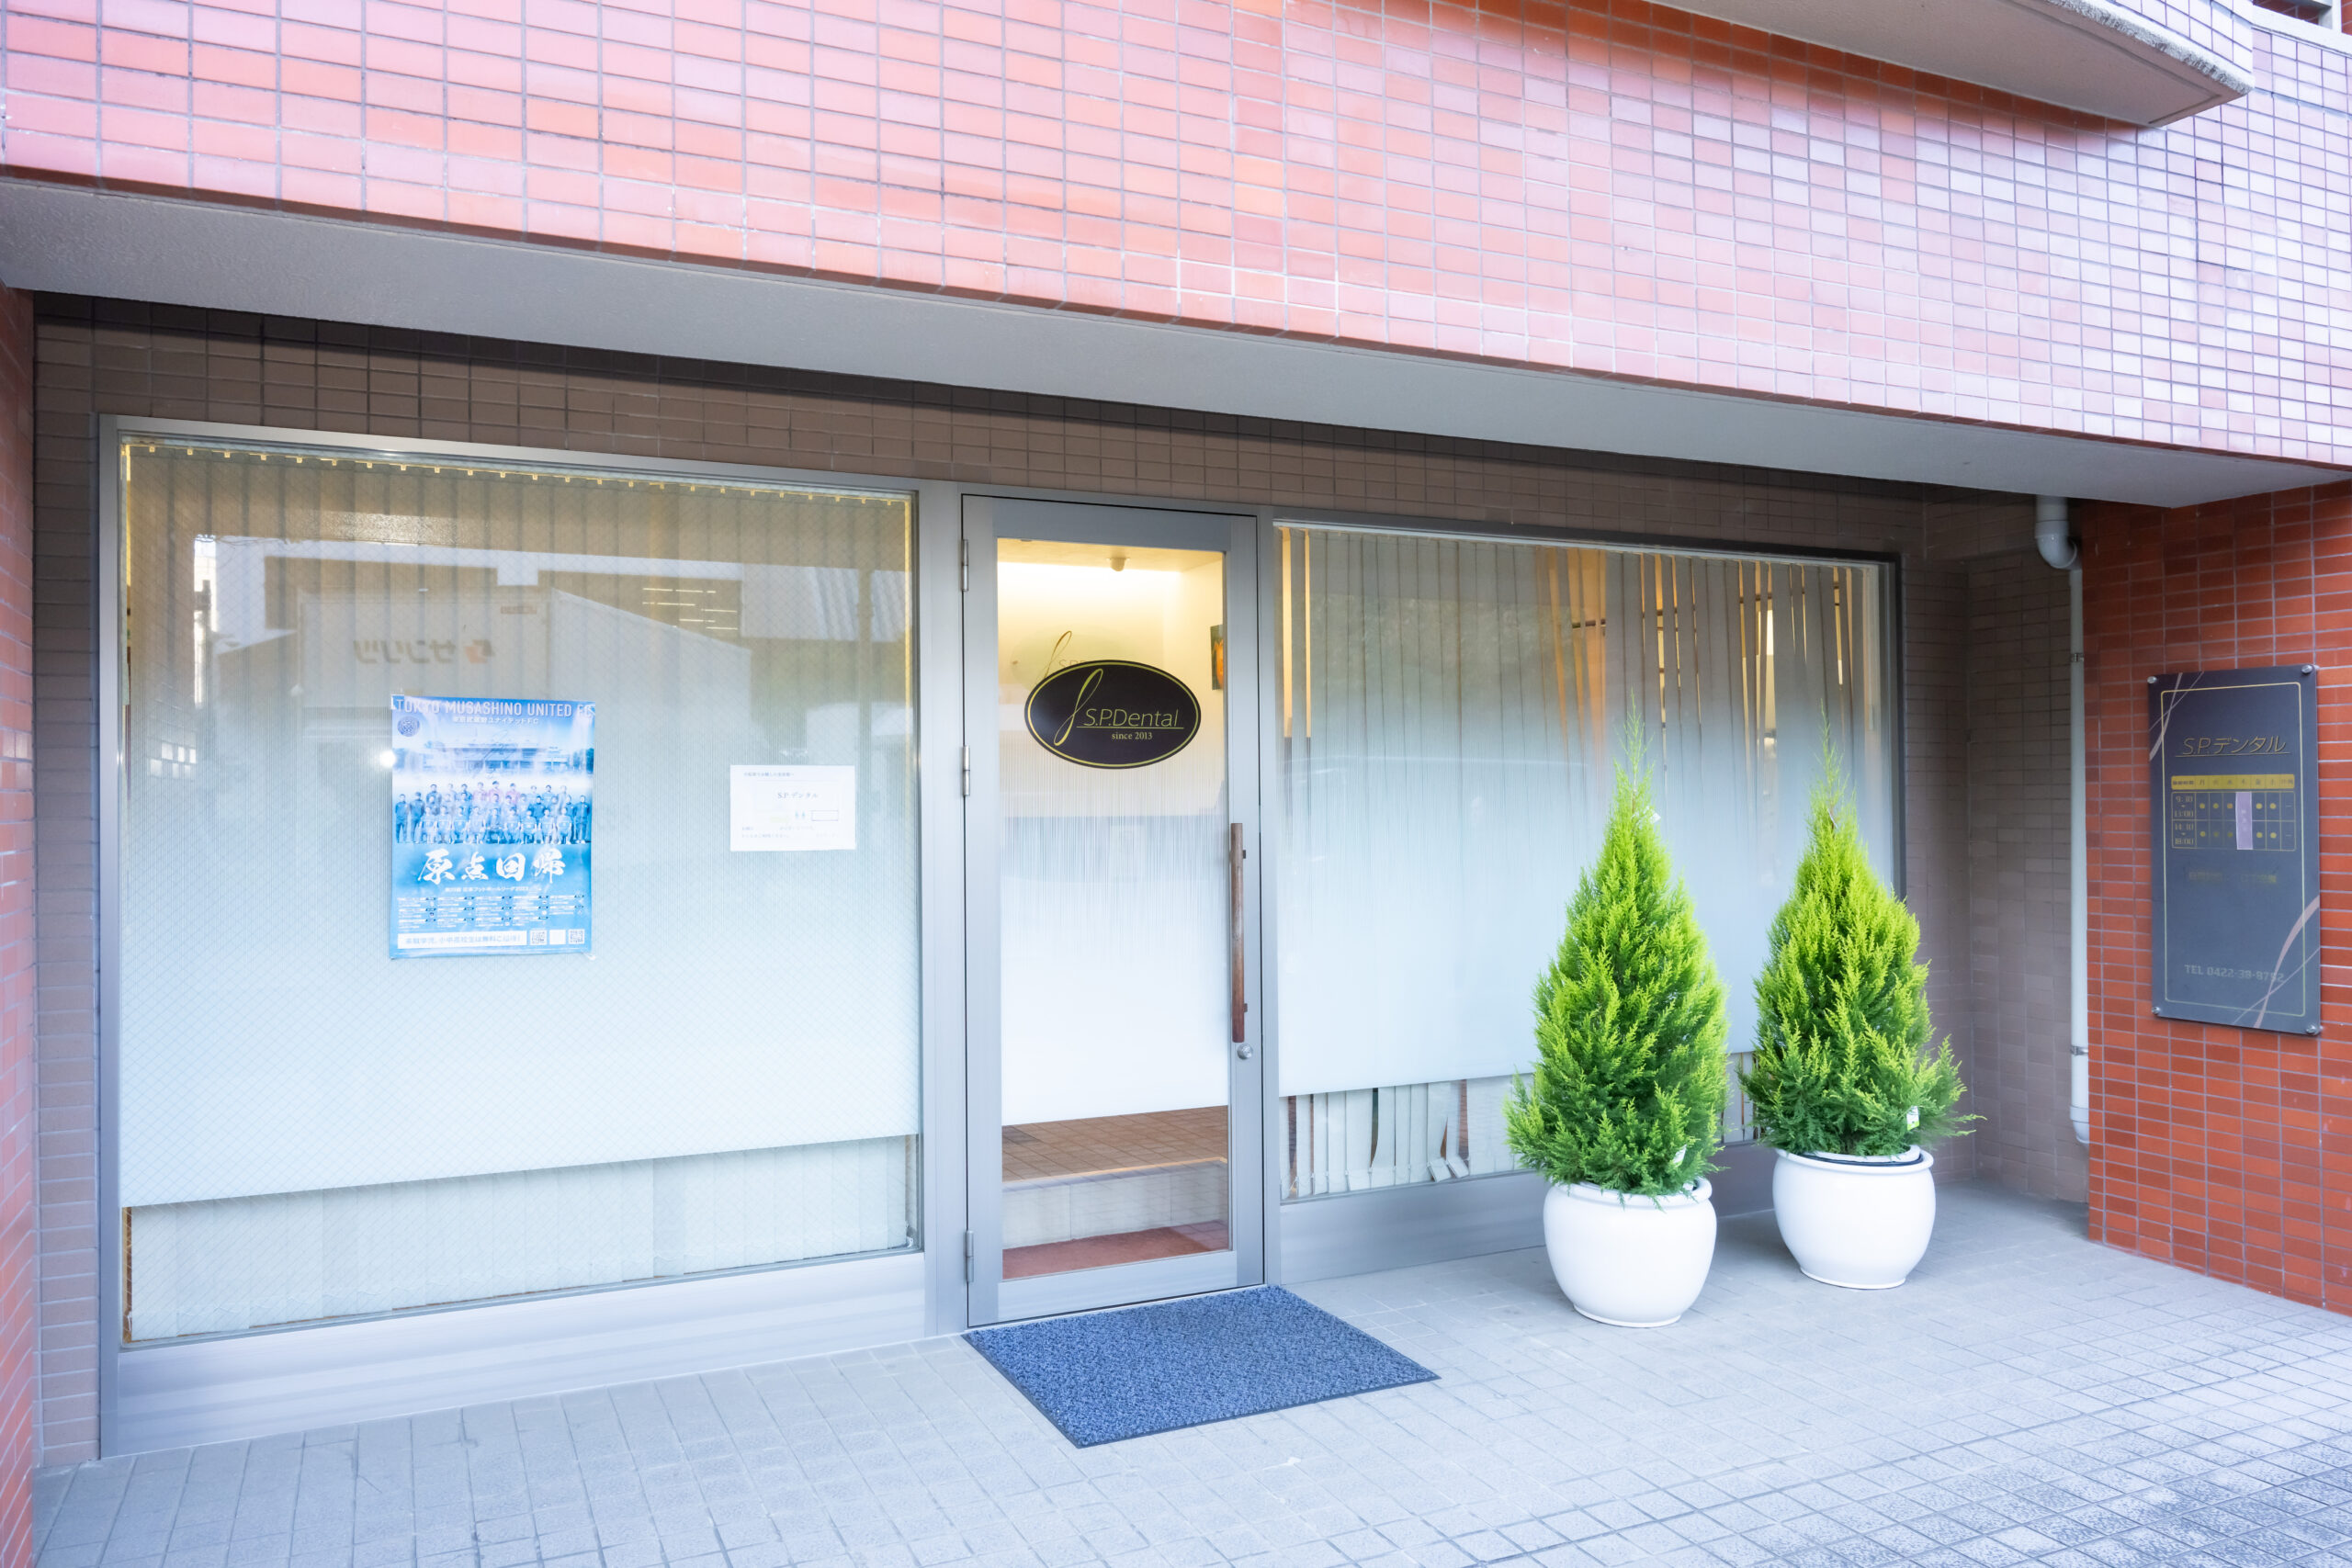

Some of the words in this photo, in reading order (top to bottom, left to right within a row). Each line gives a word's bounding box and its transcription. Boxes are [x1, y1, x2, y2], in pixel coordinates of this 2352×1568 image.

[395, 698, 440, 715] TOKYO
[445, 700, 522, 716] MUSASHINO
[527, 703, 572, 718] UNITED
[1111, 731, 1133, 740] since
[1135, 731, 1153, 740] 2013
[417, 848, 567, 885] 原点回帰
[2184, 964, 2203, 976] TEL
